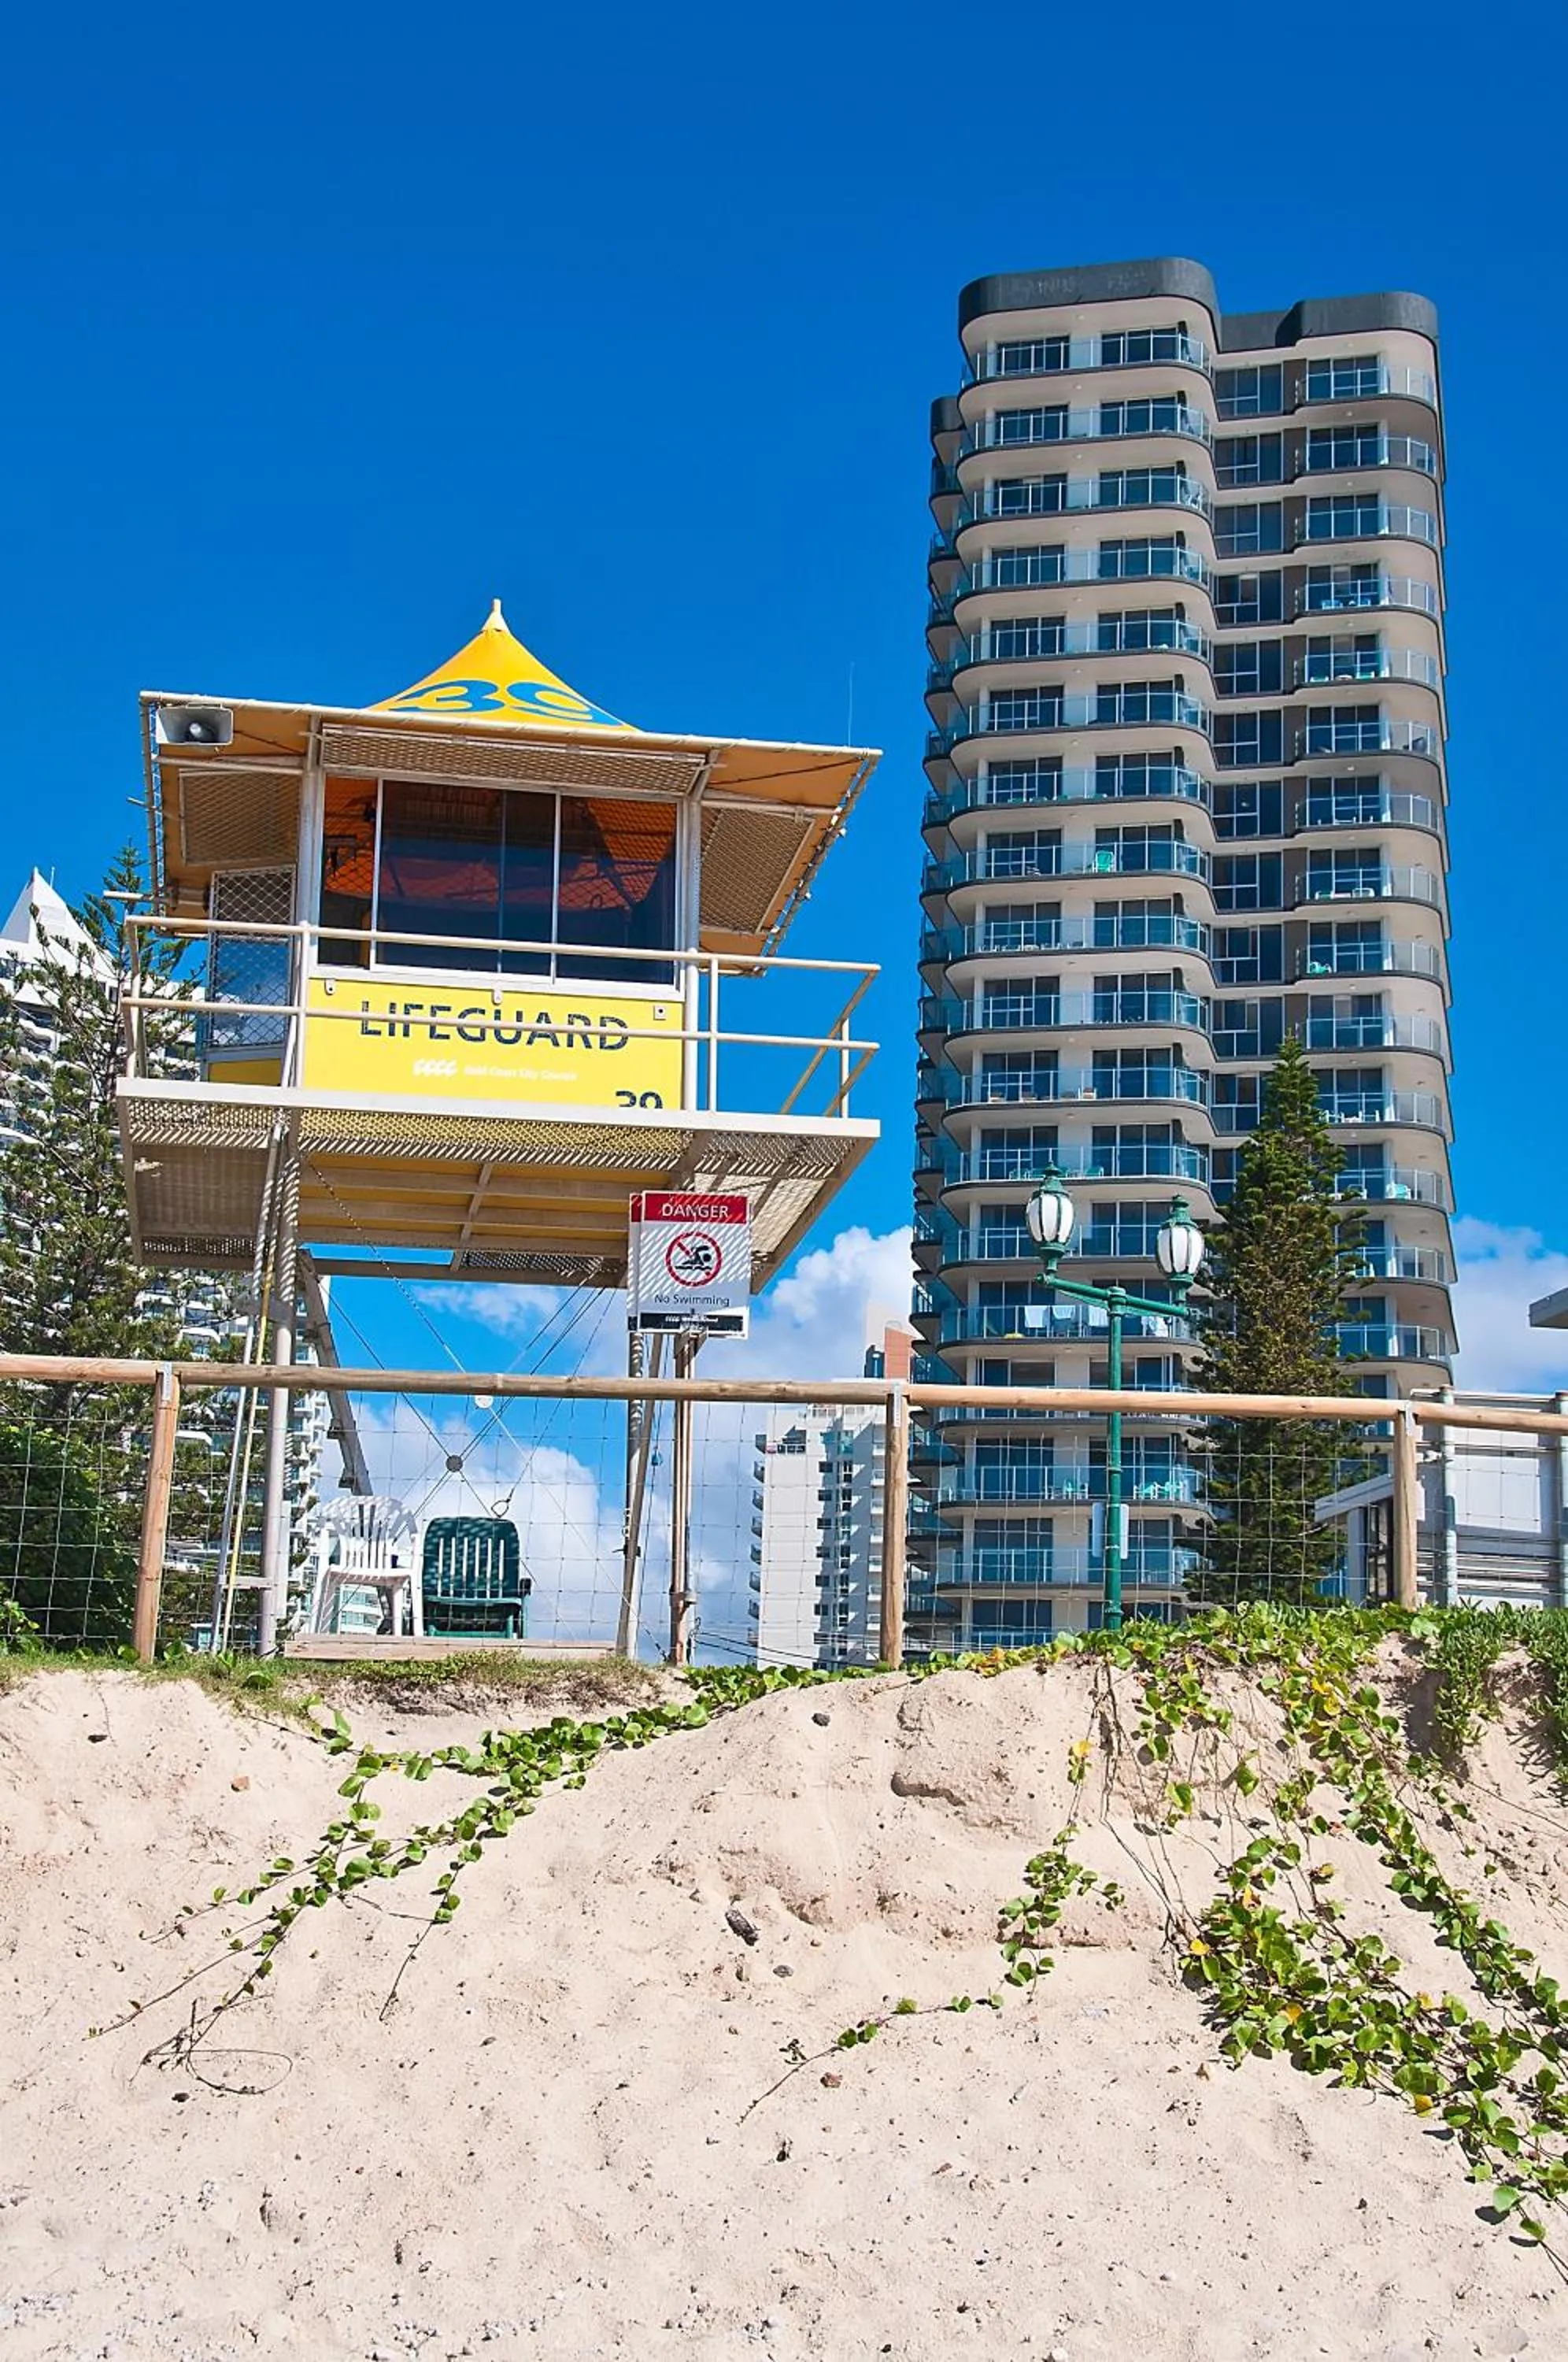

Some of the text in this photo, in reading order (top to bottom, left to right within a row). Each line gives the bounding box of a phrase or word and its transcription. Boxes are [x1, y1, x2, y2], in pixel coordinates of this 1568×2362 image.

[388, 679, 627, 725] 39
[361, 1001, 629, 1050] LIFEGUARD
[661, 1203, 729, 1218] DANGER
[654, 1294, 730, 1307] No Swimming
